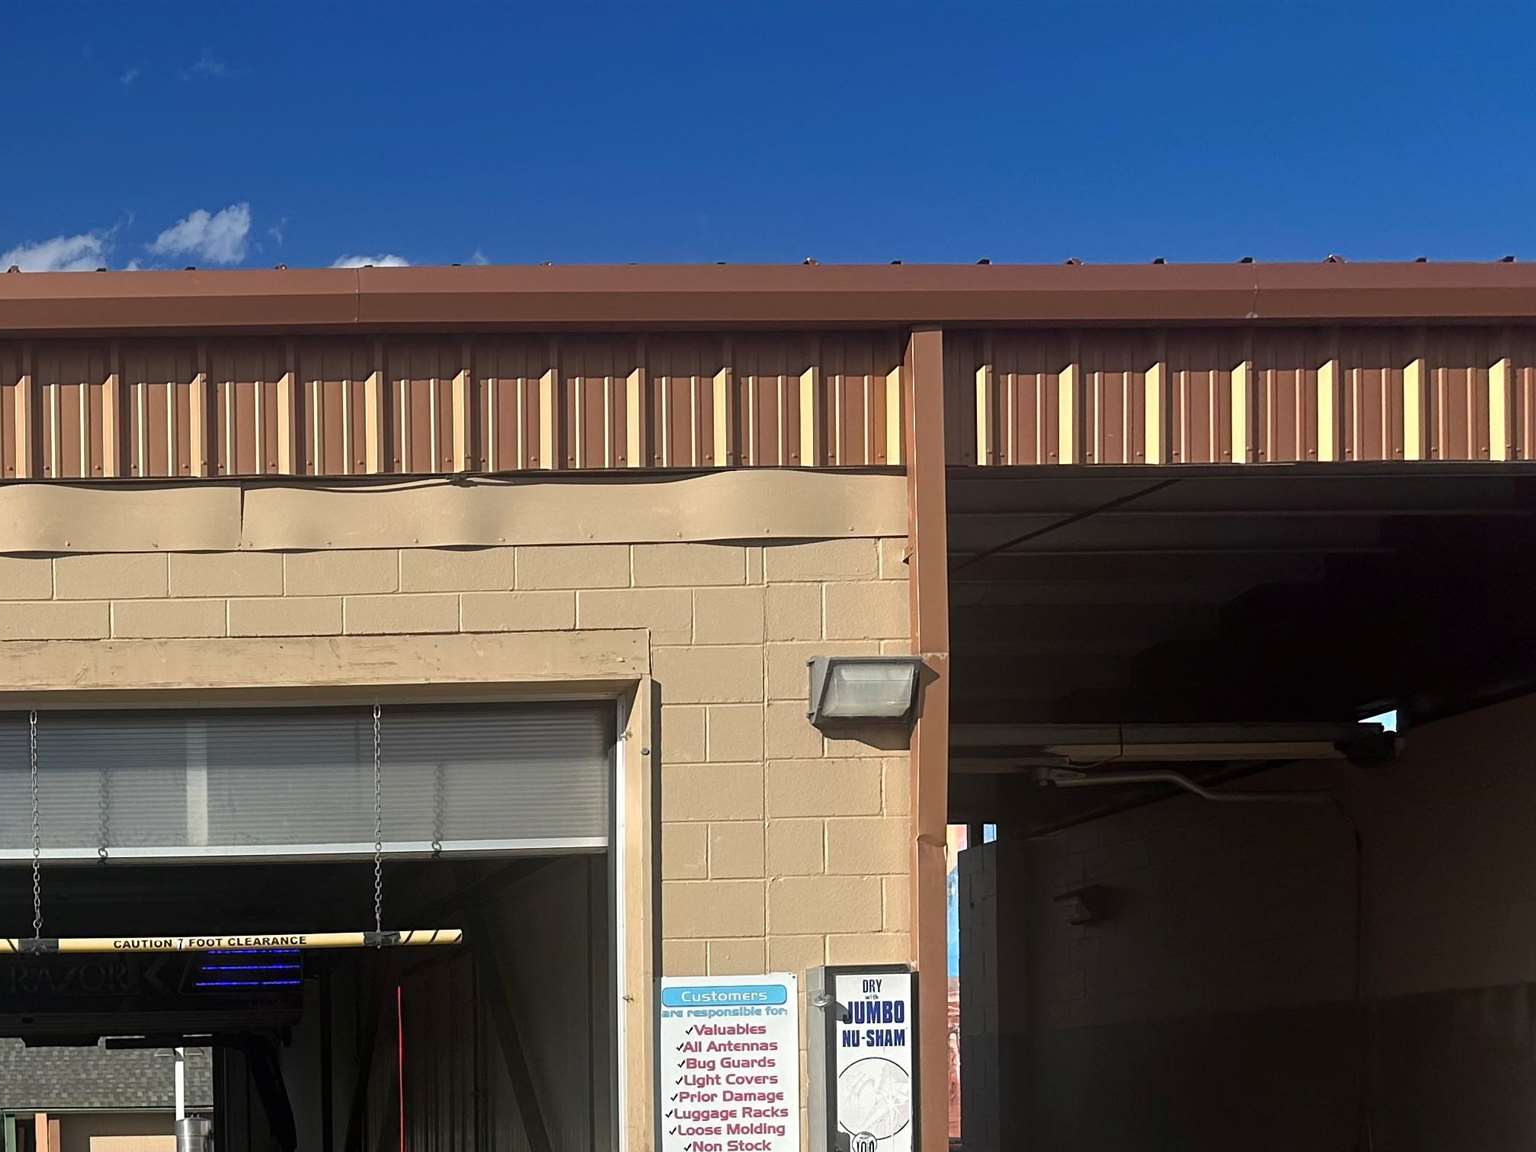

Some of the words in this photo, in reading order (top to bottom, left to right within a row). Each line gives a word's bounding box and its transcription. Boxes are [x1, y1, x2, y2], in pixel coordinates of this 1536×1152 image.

[114, 939, 172, 949] CAUTION
[189, 937, 223, 947] FOOT
[228, 936, 306, 947] CLEARANCE
[862, 979, 882, 993] DRY
[681, 991, 768, 1002] Customers
[661, 1009, 683, 1018] are
[687, 1007, 762, 1019] responsible
[842, 1000, 905, 1025] JUMBO
[693, 1023, 767, 1036] Valuables
[842, 1029, 906, 1047] NU-SHAM
[682, 1041, 702, 1053] All
[706, 1040, 778, 1052] Antennas
[686, 1058, 716, 1071] Bug
[720, 1057, 776, 1069] Guards
[684, 1074, 721, 1088] Light
[725, 1073, 778, 1085] Covers
[679, 1091, 718, 1102] Prior
[722, 1090, 784, 1103] Damage
[674, 1108, 737, 1121] Luggage
[741, 1106, 789, 1118] Racks
[677, 1124, 722, 1136] Loose
[726, 1123, 785, 1136] Molding
[692, 1141, 722, 1152] Non
[727, 1140, 772, 1152] Stock
